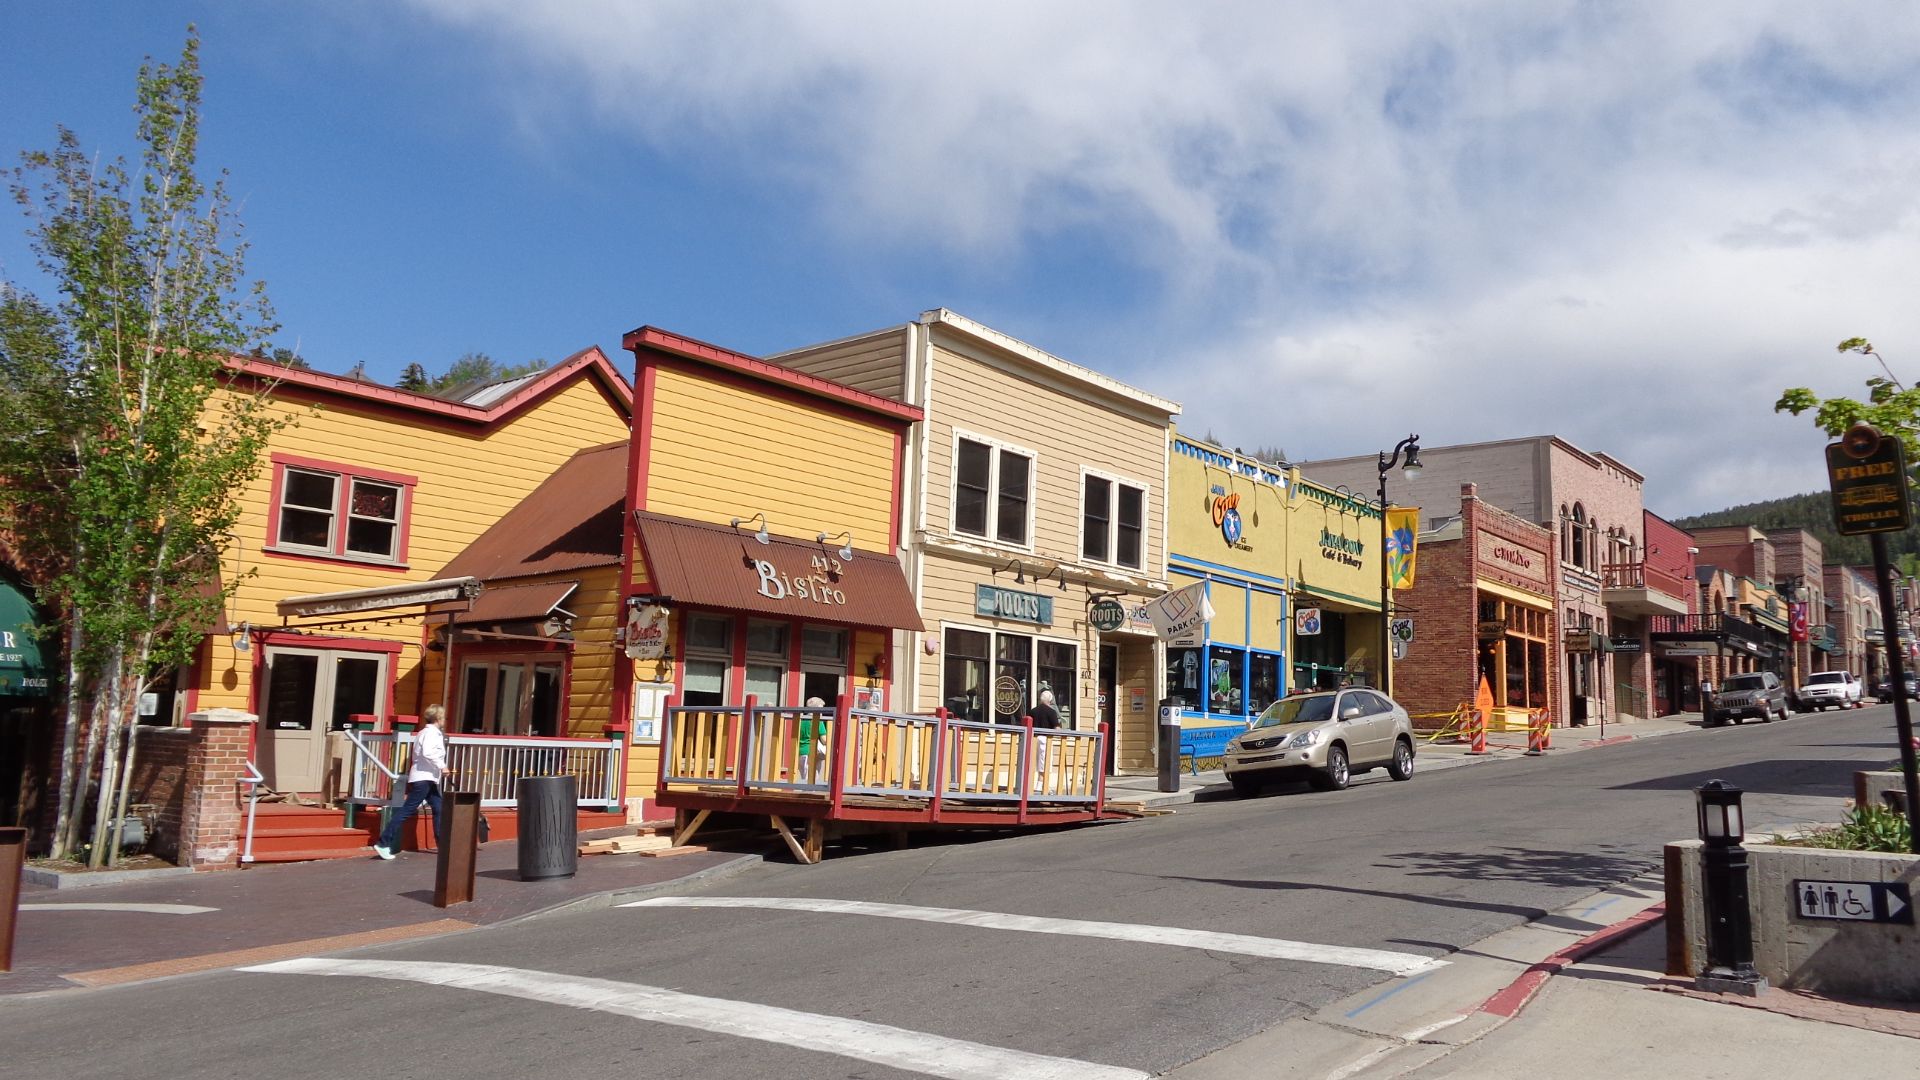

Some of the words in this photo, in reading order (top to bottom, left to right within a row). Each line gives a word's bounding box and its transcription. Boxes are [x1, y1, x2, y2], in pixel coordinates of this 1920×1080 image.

[1834, 462, 1894, 480] FREE
[811, 555, 843, 575] 412
[754, 559, 846, 605] Bistro
[993, 591, 1038, 618] ROOTS
[1092, 609, 1122, 622] ROOTS
[1167, 621, 1188, 635] PARK
